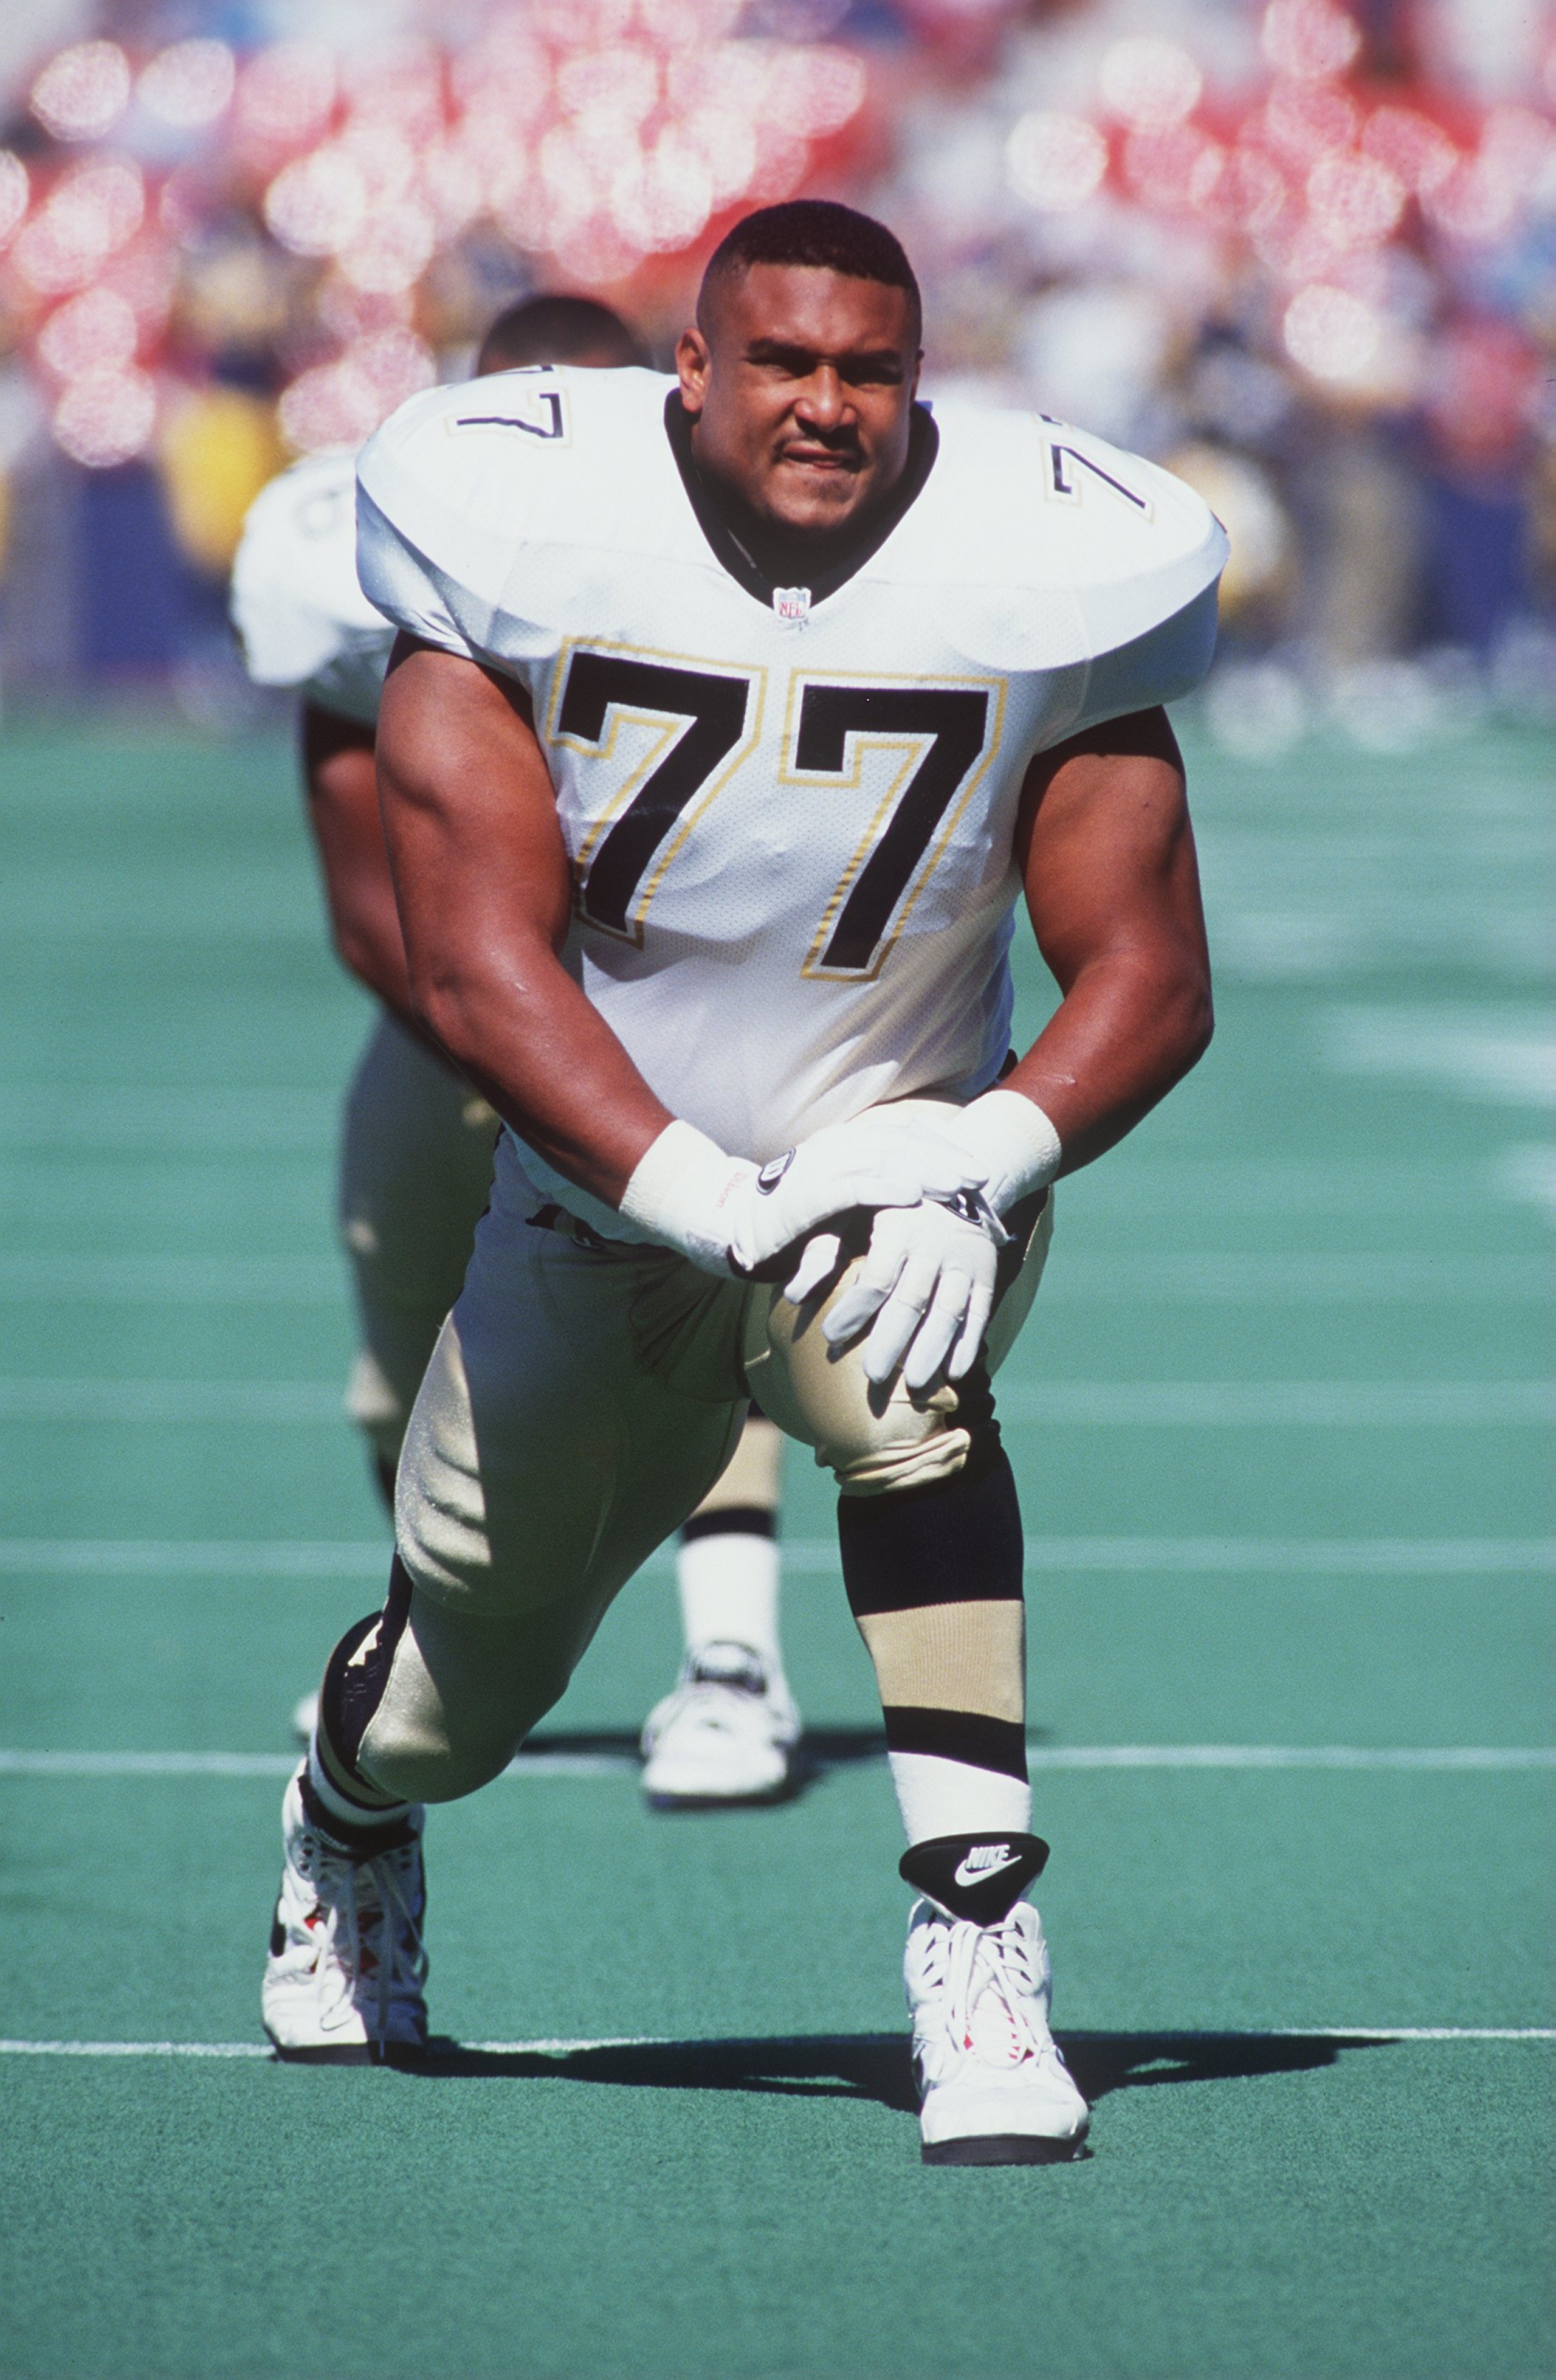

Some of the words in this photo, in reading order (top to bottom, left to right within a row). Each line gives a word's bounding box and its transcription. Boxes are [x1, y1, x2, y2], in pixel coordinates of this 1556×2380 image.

[780, 601, 805, 619] NFL
[546, 636, 1008, 982] 77
[965, 1844, 1010, 1869] NIKE
